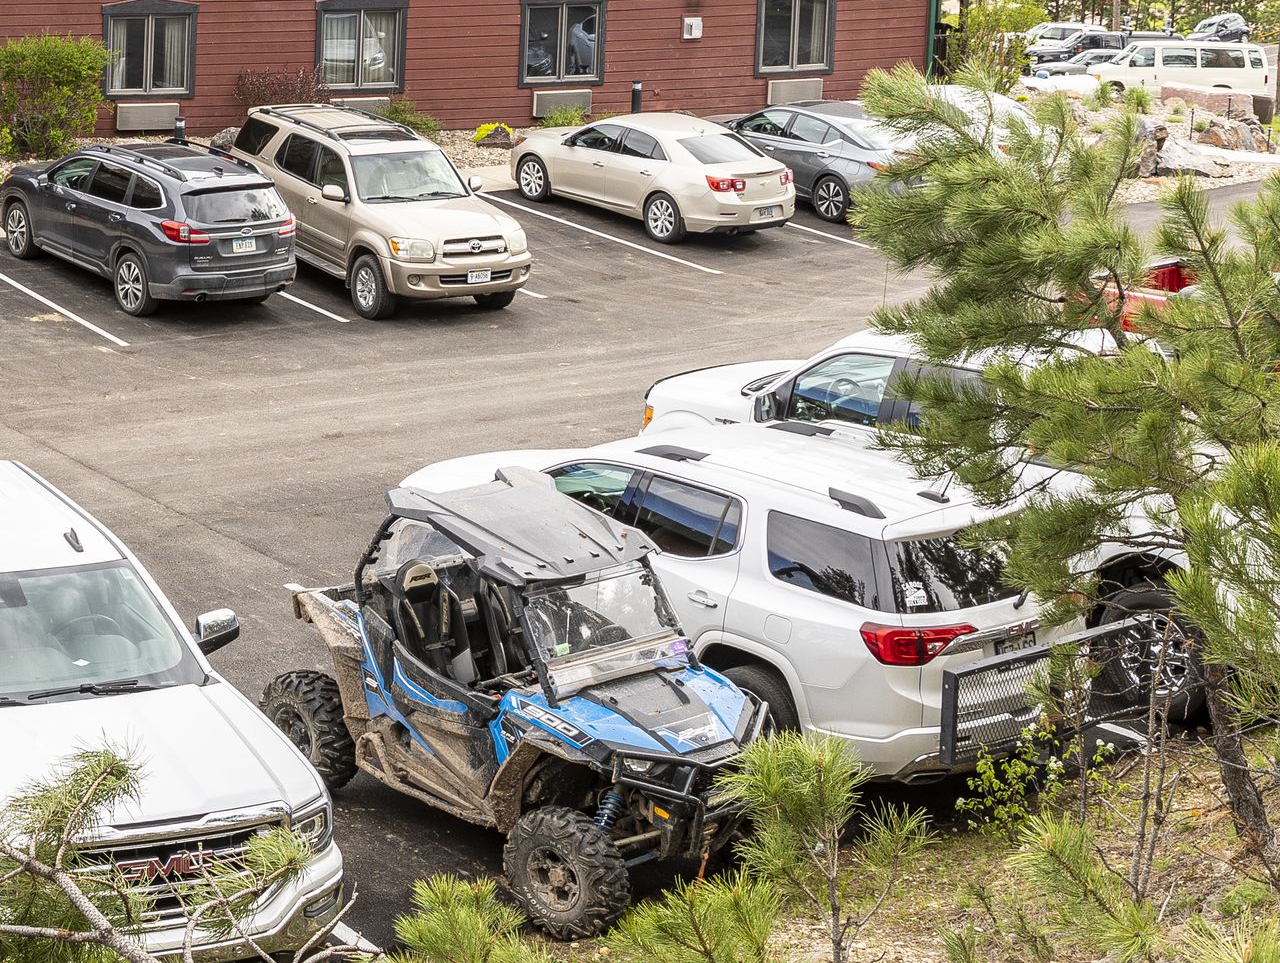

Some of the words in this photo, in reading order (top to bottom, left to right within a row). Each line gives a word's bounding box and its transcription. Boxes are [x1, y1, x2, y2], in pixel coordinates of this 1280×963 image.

[409, 573, 431, 583] RZR
[1007, 620, 1040, 638] GMC
[523, 705, 579, 736] 900
[115, 849, 213, 881] GMC
